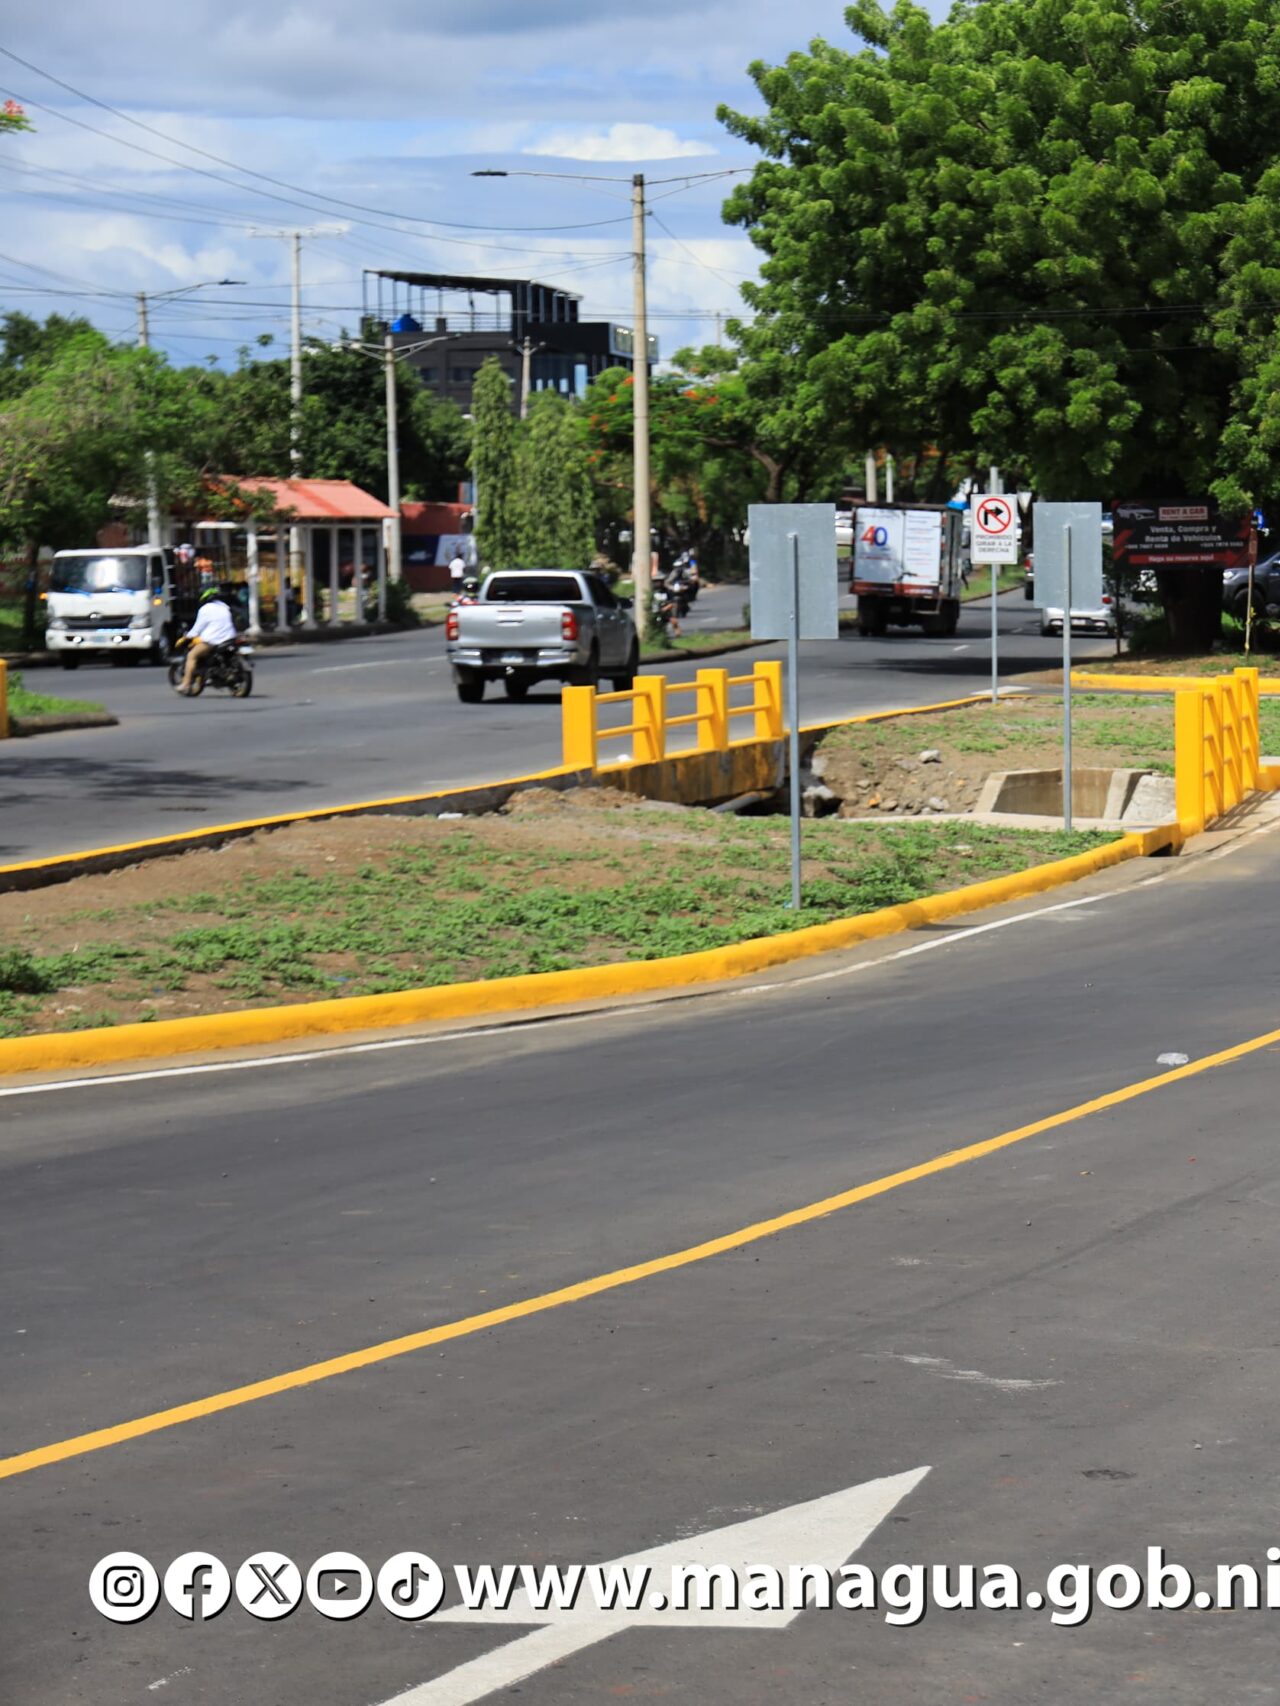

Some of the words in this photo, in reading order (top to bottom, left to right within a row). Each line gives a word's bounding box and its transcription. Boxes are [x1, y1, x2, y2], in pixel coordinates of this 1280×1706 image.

[1177, 525, 1209, 533] Compra
[861, 525, 888, 547] 40
[1144, 535, 1169, 543] Renta
